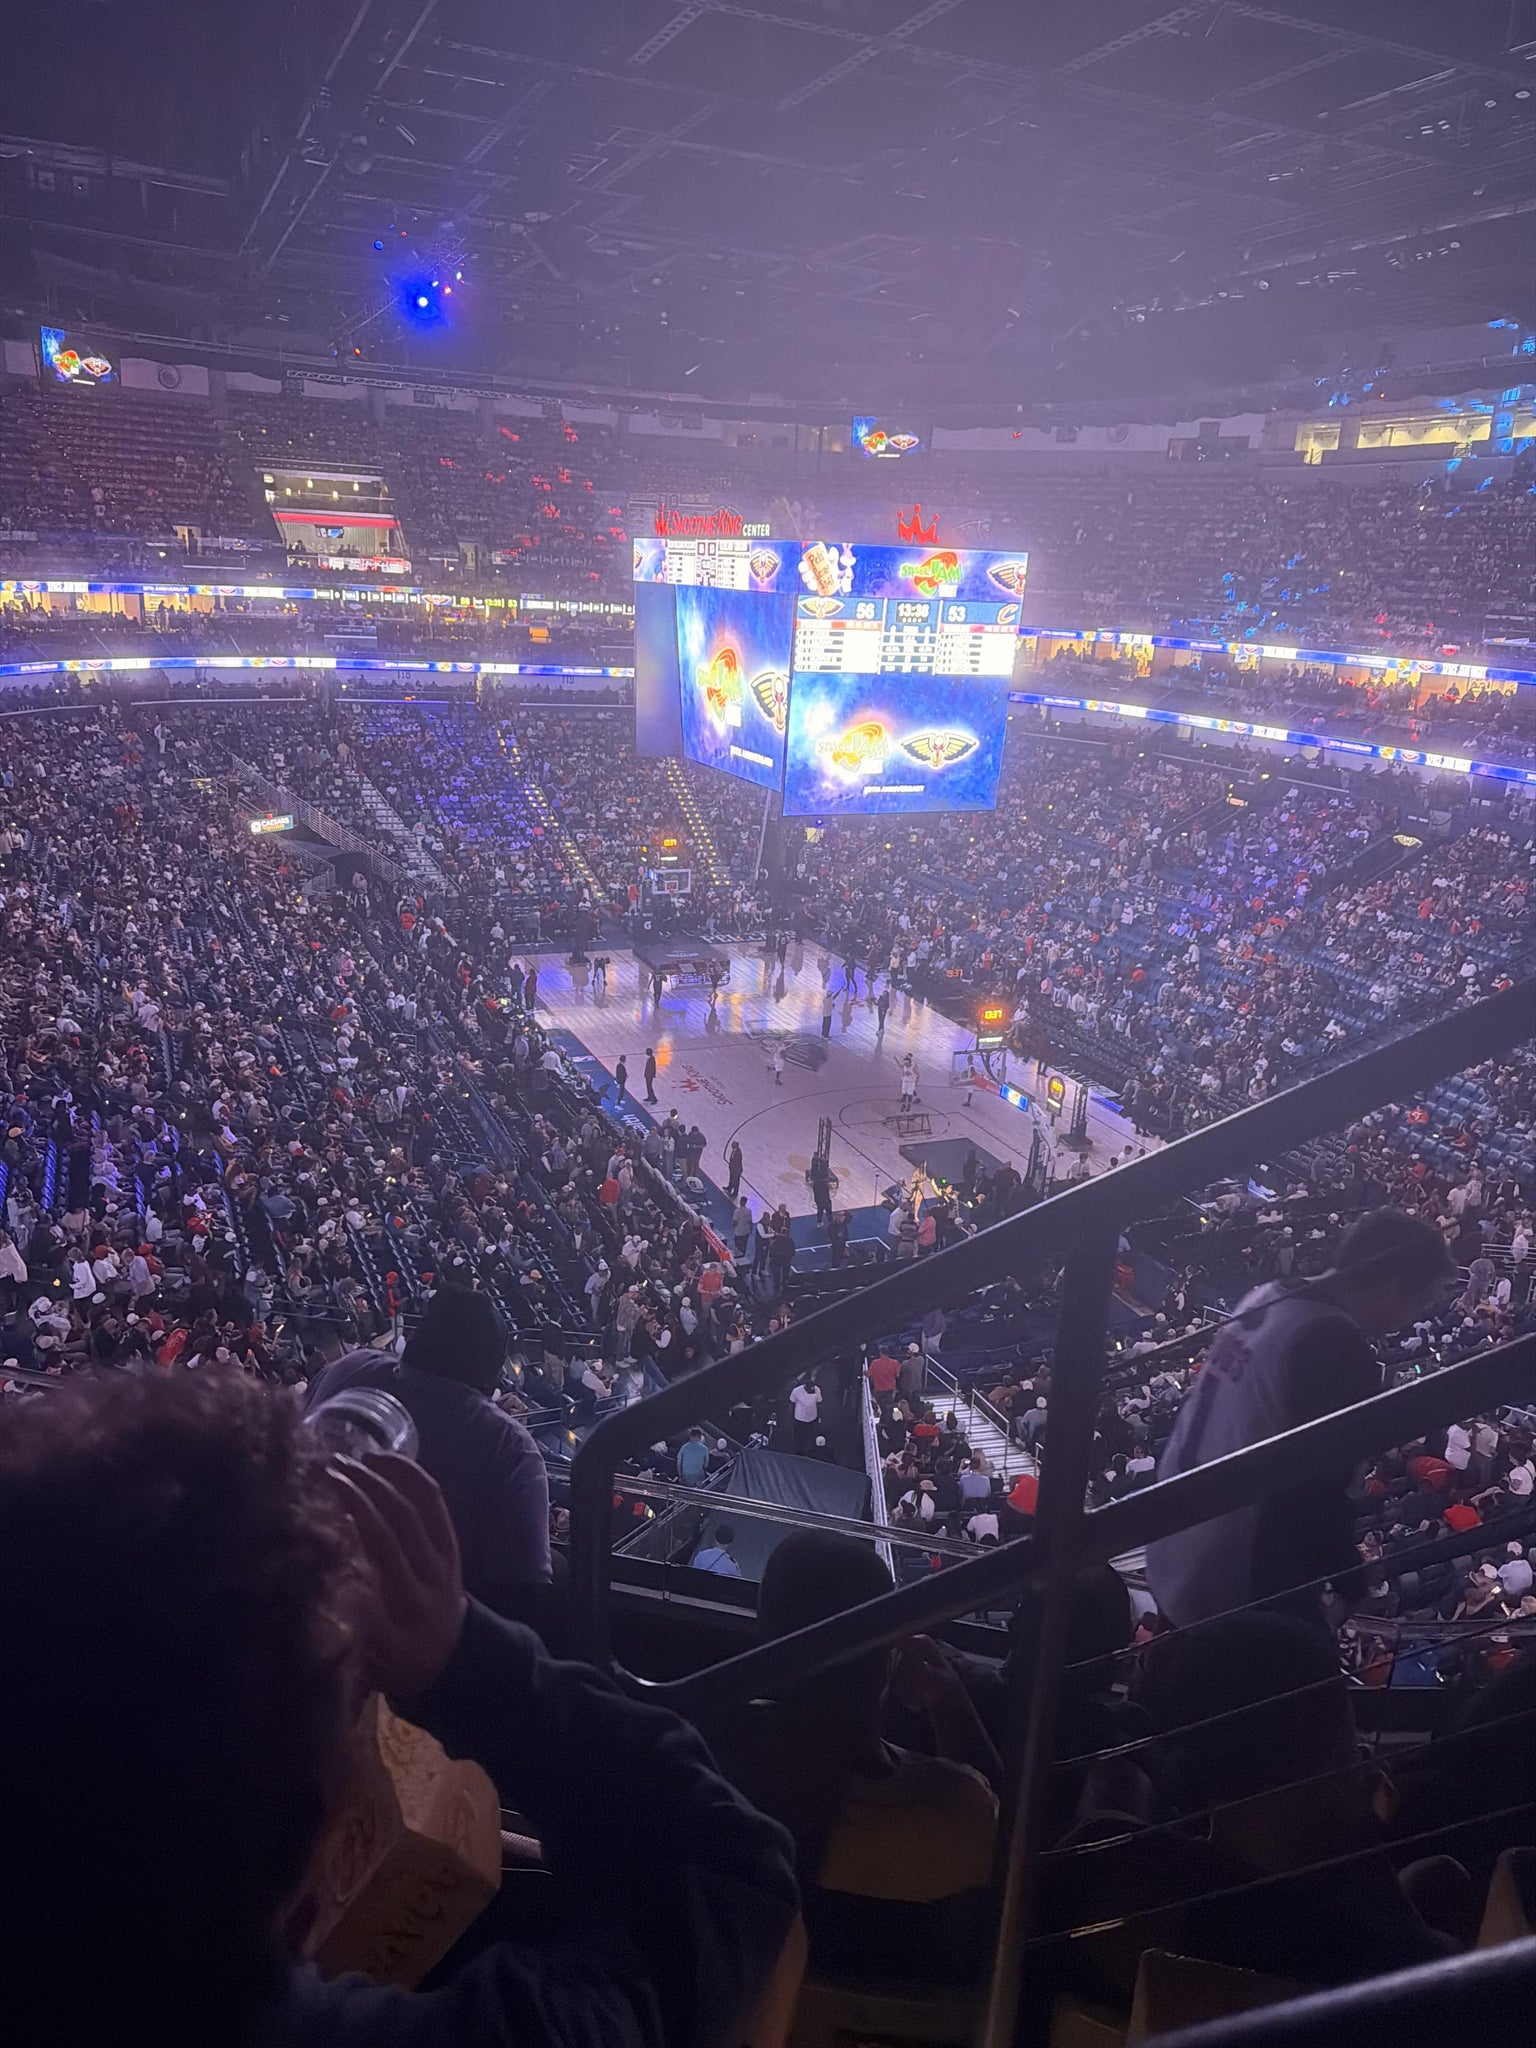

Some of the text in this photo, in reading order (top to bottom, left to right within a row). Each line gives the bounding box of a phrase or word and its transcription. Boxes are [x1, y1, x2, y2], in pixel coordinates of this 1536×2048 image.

[671, 509, 770, 537] SMOOTHIE KING CENTER
[901, 559, 962, 584] SPACE JAM
[856, 602, 875, 619] 56
[898, 602, 930, 617] 13:38
[948, 605, 967, 622] 53
[881, 785, 925, 793] ANNIVERSARY
